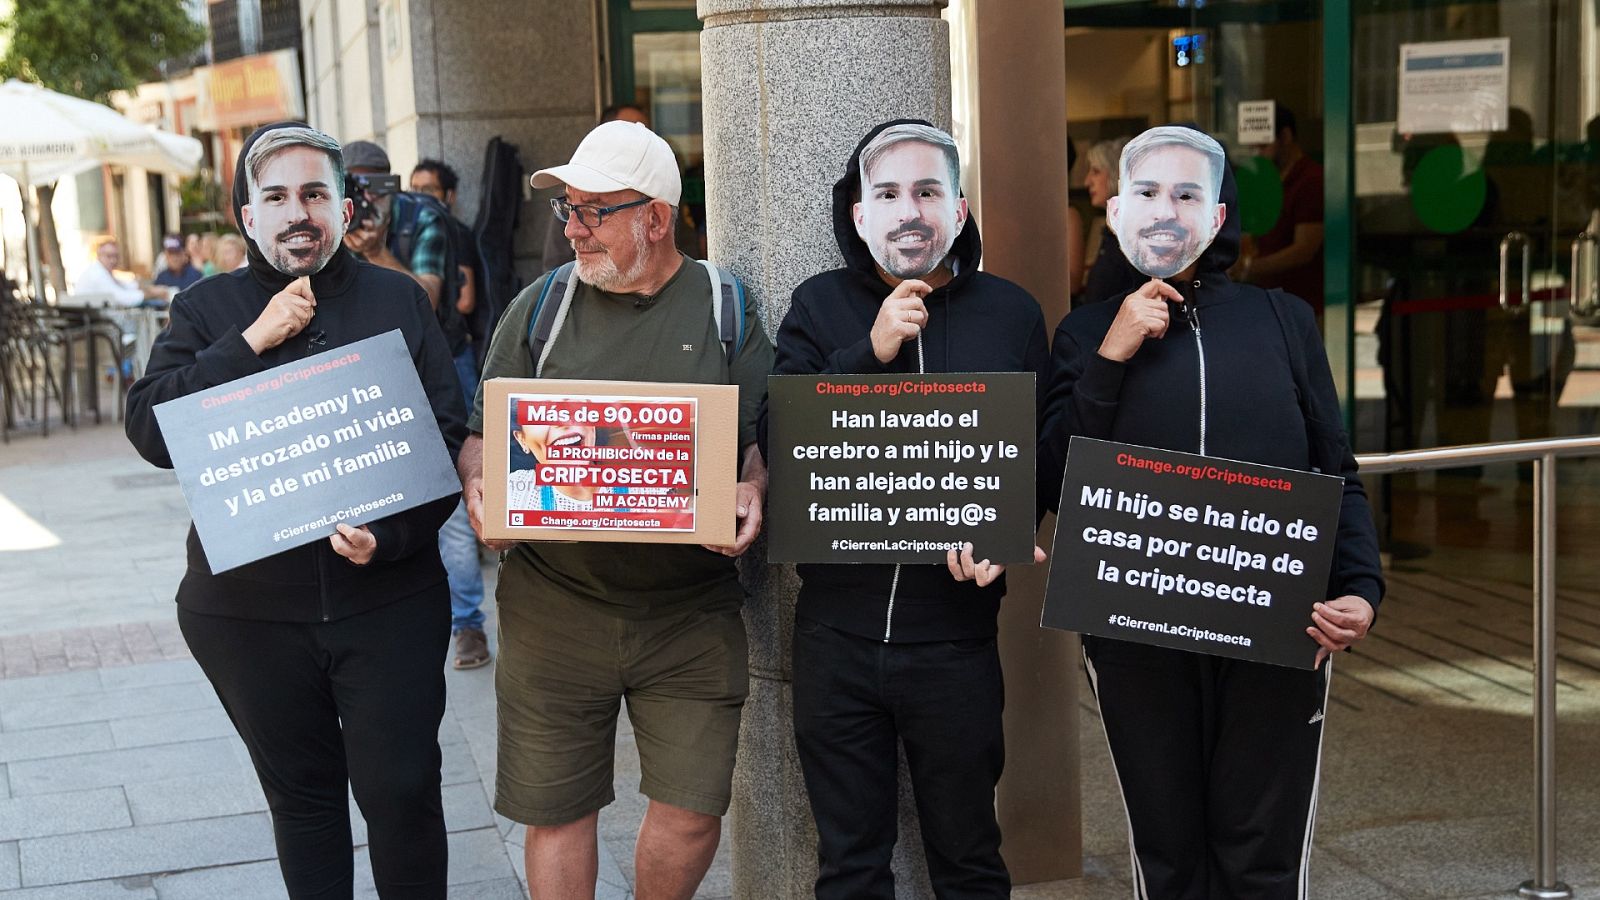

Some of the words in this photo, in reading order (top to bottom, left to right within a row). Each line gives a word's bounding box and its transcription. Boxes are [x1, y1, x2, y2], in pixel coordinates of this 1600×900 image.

[201, 352, 360, 409] Change.org/Criptosecta
[816, 382, 986, 396] Change.org/Criptosecta
[208, 428, 239, 450] IM
[245, 393, 348, 440] Academy
[352, 384, 382, 404] ha
[528, 405, 570, 421] Más
[575, 407, 599, 422] de
[604, 407, 683, 424] 90.000
[832, 410, 874, 428] Han
[880, 410, 953, 427] lavado
[958, 409, 978, 427] el
[200, 436, 330, 487] destrozado
[333, 419, 362, 442] mi
[363, 406, 414, 434] vida
[632, 432, 661, 440] firmas
[664, 433, 690, 442] piden
[548, 447, 560, 458] la
[563, 446, 654, 460] PROHIBICIÓN
[657, 449, 673, 461] de
[677, 449, 689, 461] la
[793, 442, 880, 459] cerebro
[884, 445, 897, 459] a
[902, 441, 929, 459] mi
[934, 440, 975, 463] hijo
[980, 444, 992, 463] y
[999, 441, 1018, 458] le
[224, 494, 239, 516] y
[243, 487, 265, 506] la
[269, 477, 298, 497] de
[301, 463, 331, 487] mi
[333, 438, 411, 476] familia
[541, 467, 687, 485] CRIPTOSECTA
[810, 472, 850, 490] han
[855, 472, 935, 494] alejado
[940, 472, 968, 490] de
[973, 476, 1000, 490] su
[1117, 453, 1292, 491] Change.org/Criptosecta
[597, 496, 613, 507] IM
[616, 496, 689, 508] ACADEMY
[1080, 485, 1112, 509] Mi
[1116, 492, 1163, 519] hijo
[1168, 506, 1198, 523] se
[1203, 505, 1234, 528] ha
[1240, 510, 1280, 536] ido
[1285, 519, 1318, 542] de
[273, 492, 403, 542] #CierrenLaCriptosecta
[541, 517, 660, 528] Change.org/Criptosecta
[808, 503, 882, 522] familia
[887, 506, 900, 525] y
[905, 503, 997, 526] amig@s
[831, 540, 965, 552] #CierrenLaCriptosect
[1082, 526, 1142, 550] casa
[1146, 536, 1192, 557] por
[1196, 545, 1266, 571] culpa
[1272, 553, 1304, 576] de
[1097, 560, 1119, 583] la
[1125, 568, 1272, 607] criptosecta
[1108, 614, 1251, 647] #CierrenLaCriptosecta
